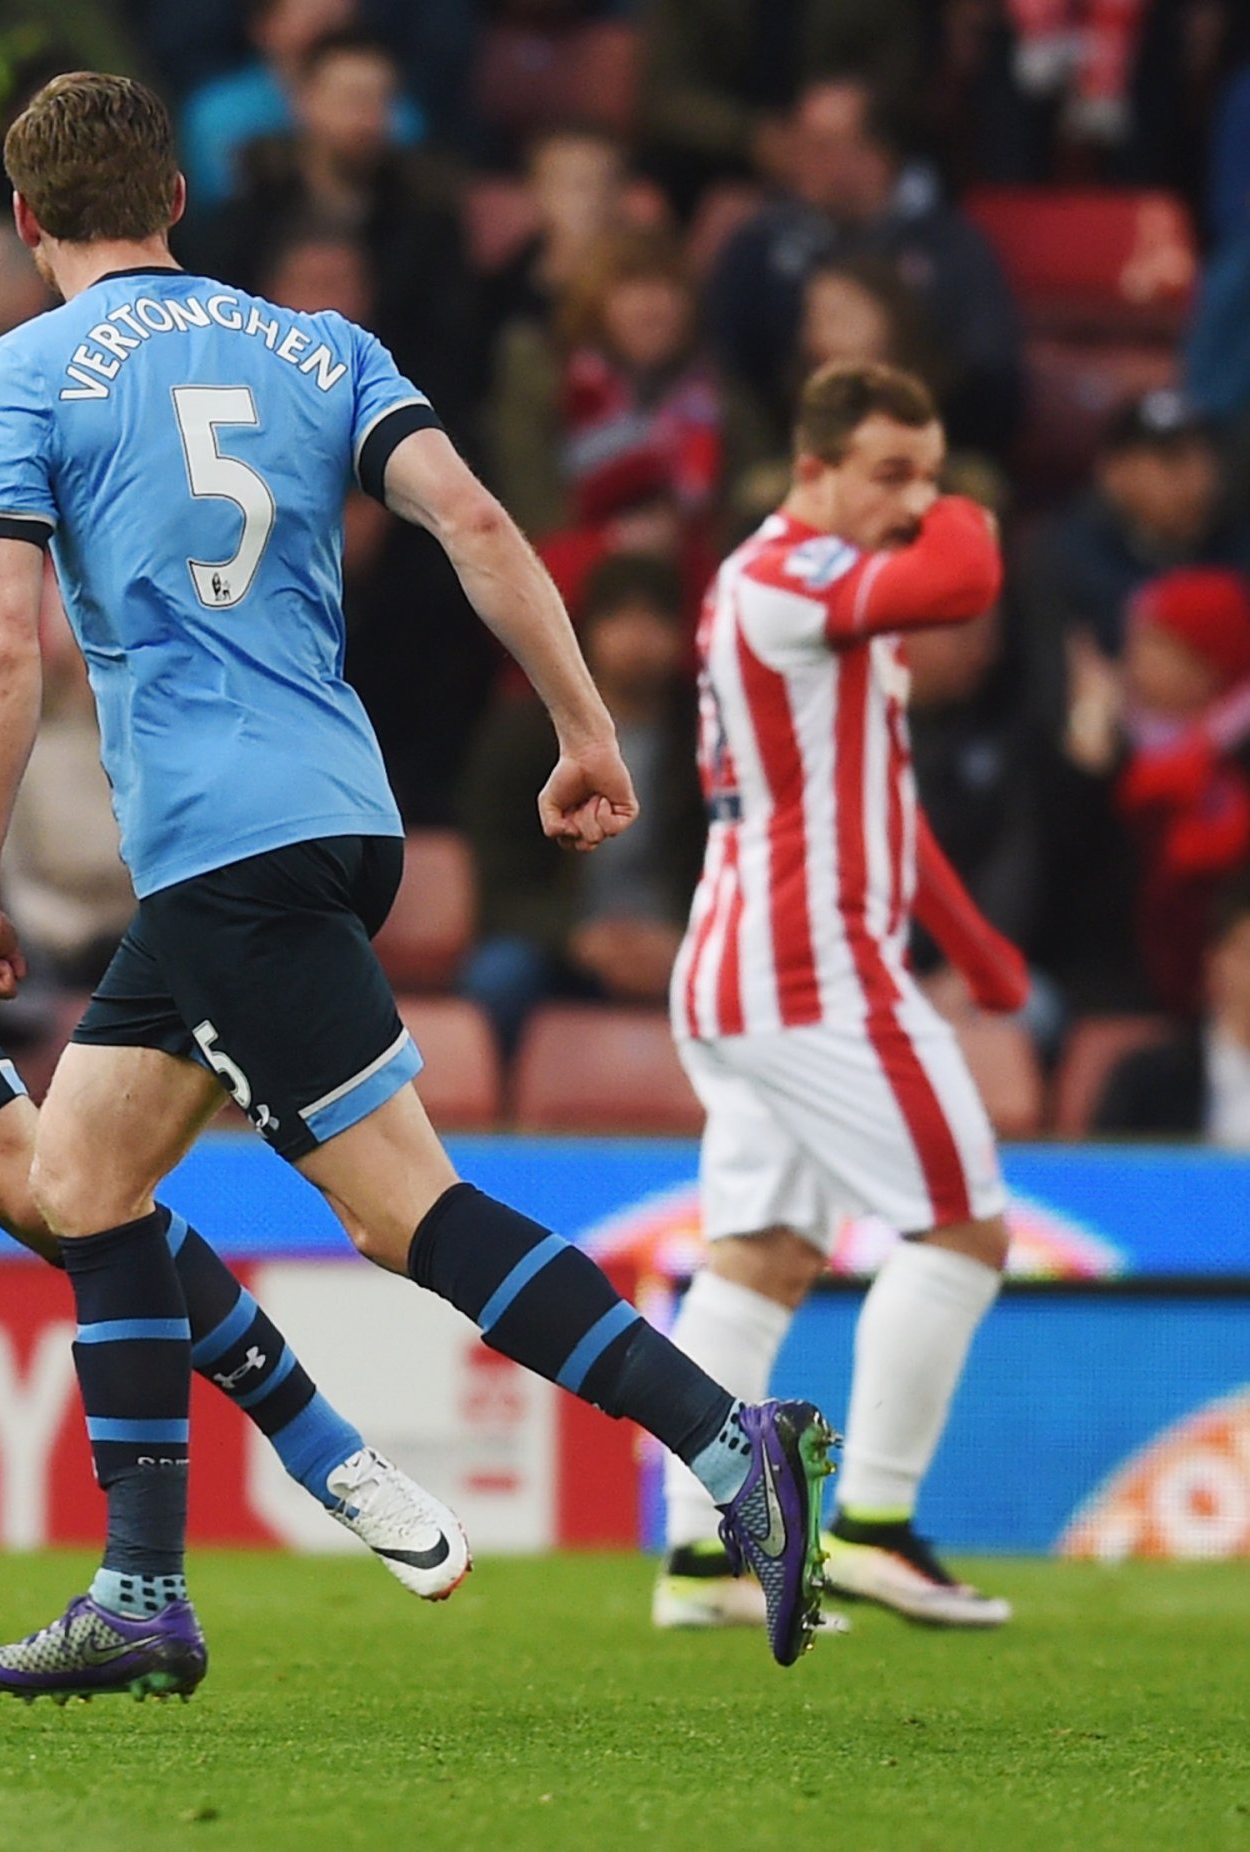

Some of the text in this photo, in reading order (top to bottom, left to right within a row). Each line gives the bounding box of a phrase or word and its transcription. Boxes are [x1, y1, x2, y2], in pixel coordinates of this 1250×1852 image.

[58, 294, 348, 401] VERTONGHEN
[171, 384, 276, 610] 5
[191, 1018, 252, 1109] 5
